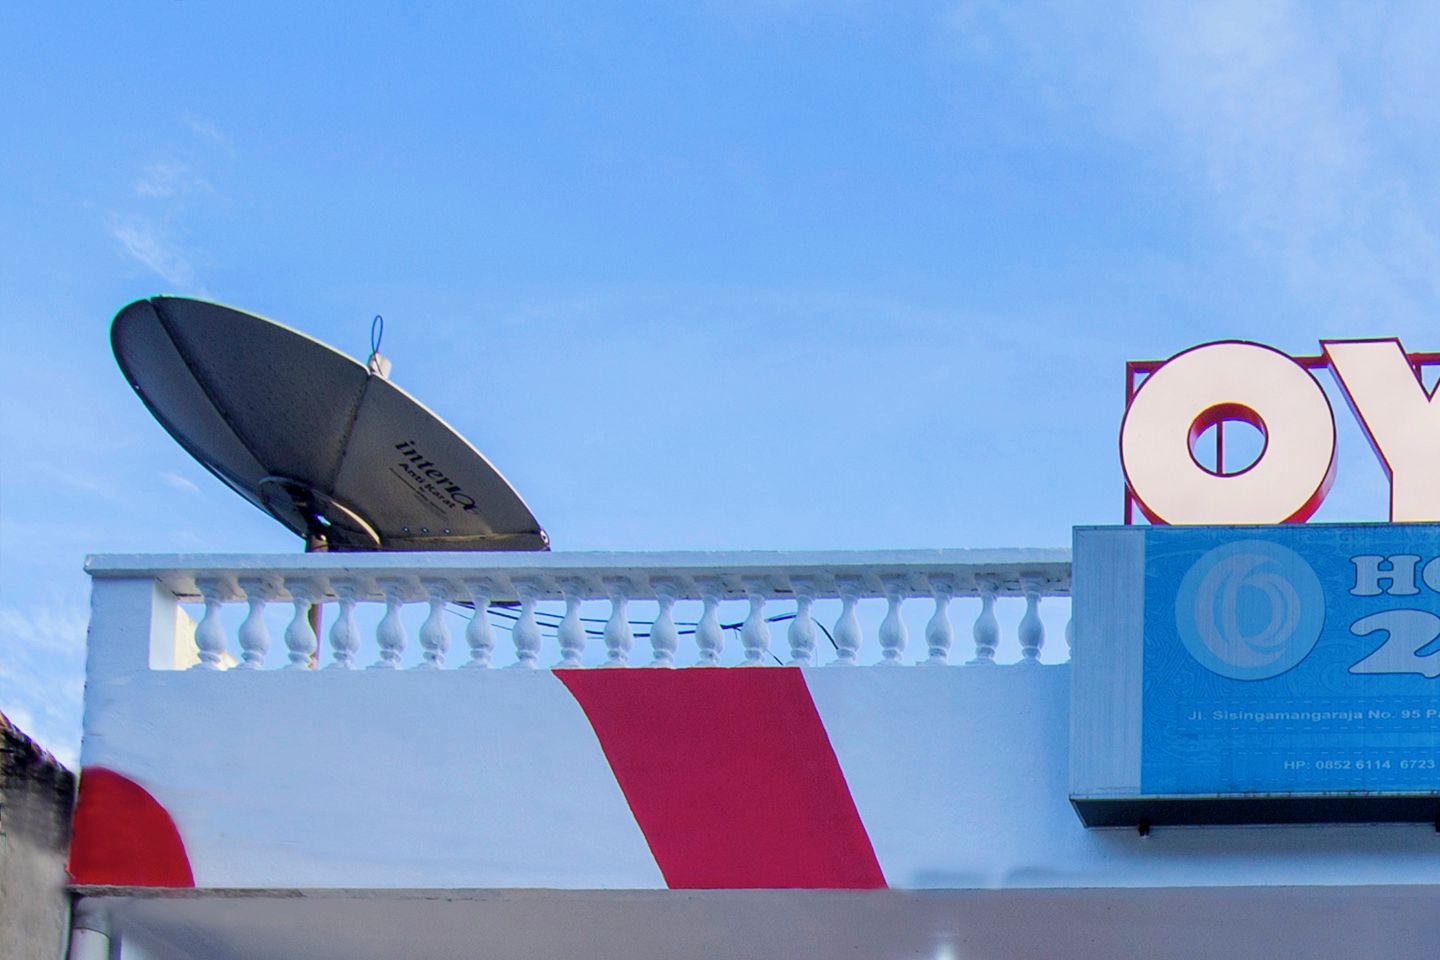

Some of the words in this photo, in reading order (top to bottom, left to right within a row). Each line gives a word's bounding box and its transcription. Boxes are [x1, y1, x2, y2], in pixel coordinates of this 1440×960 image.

[1212, 709, 1363, 723] Sisingamangaraja
[1367, 709, 1395, 720] No.
[1400, 708, 1421, 719] 95
[1284, 759, 1311, 770] HP:
[1315, 759, 1351, 770] 0852
[1355, 759, 1391, 770] 6114
[1399, 758, 1436, 769] 6723
